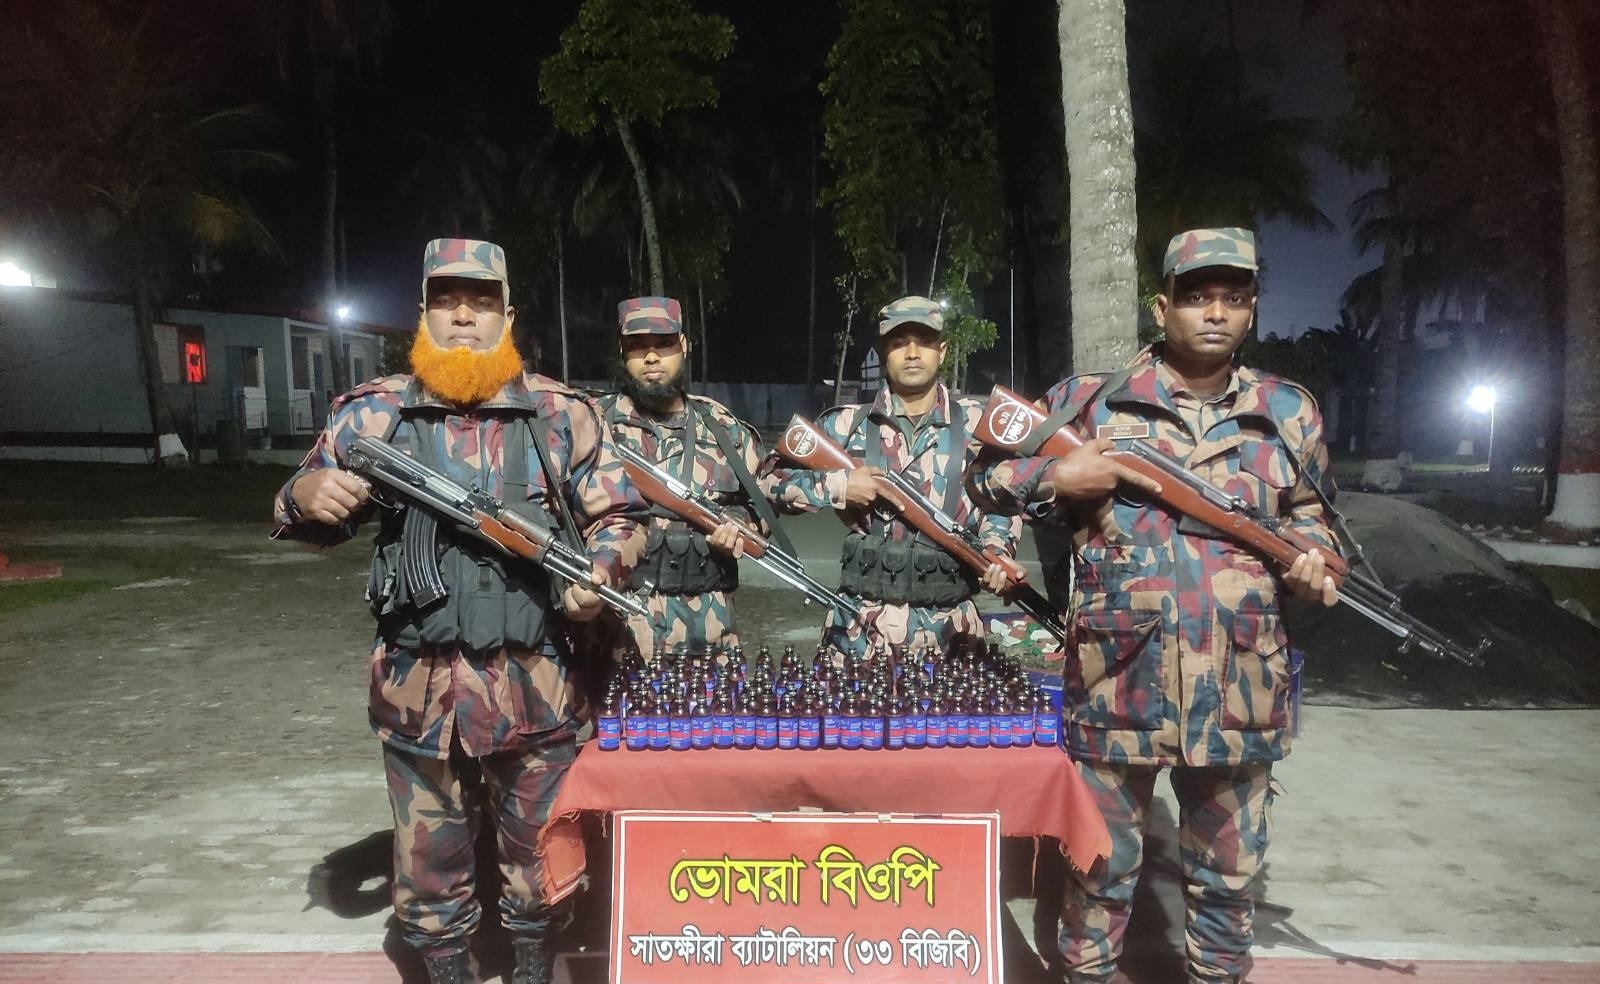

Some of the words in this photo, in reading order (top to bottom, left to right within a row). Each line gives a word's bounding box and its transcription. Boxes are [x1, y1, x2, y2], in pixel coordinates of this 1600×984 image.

[669, 854, 808, 905] ভোমরা
[814, 845, 942, 907] বিওপি
[628, 924, 725, 966] সাতক্ষীরা
[729, 926, 837, 967] ব্যাটালিয়ন
[843, 932, 893, 975] (৩৩
[899, 927, 982, 976] বিজিবি)
